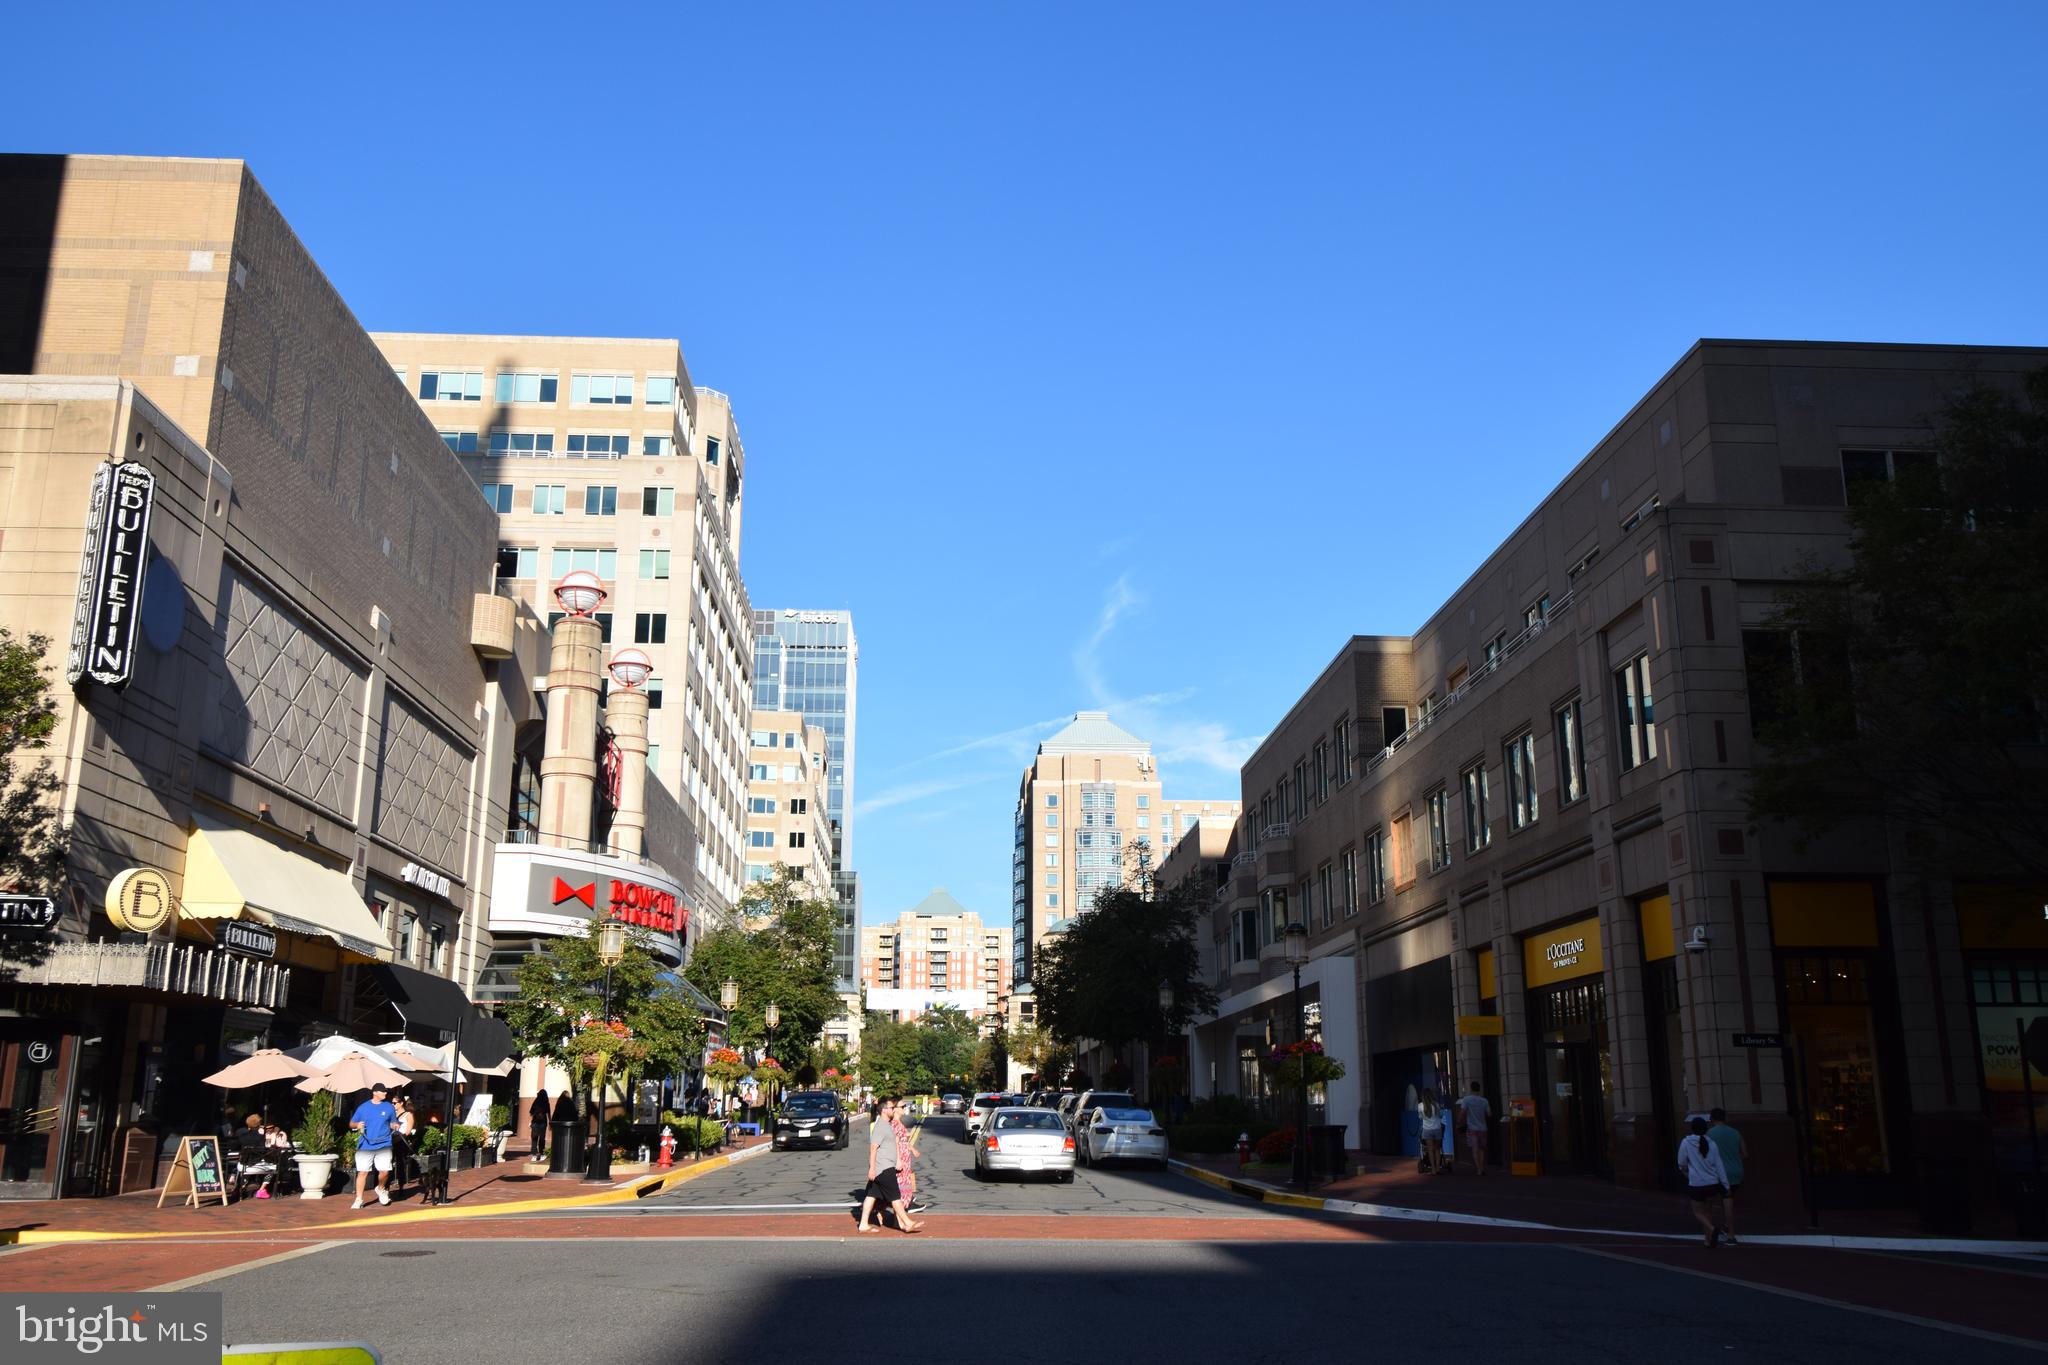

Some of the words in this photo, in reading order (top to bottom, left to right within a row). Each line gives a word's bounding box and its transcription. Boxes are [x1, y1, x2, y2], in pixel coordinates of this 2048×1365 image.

[119, 474, 150, 489] TED'S
[97, 486, 143, 671] BULLETIN
[132, 880, 163, 919] B
[231, 927, 273, 951] BULLETIN
[1740, 1036, 1766, 1047] Library
